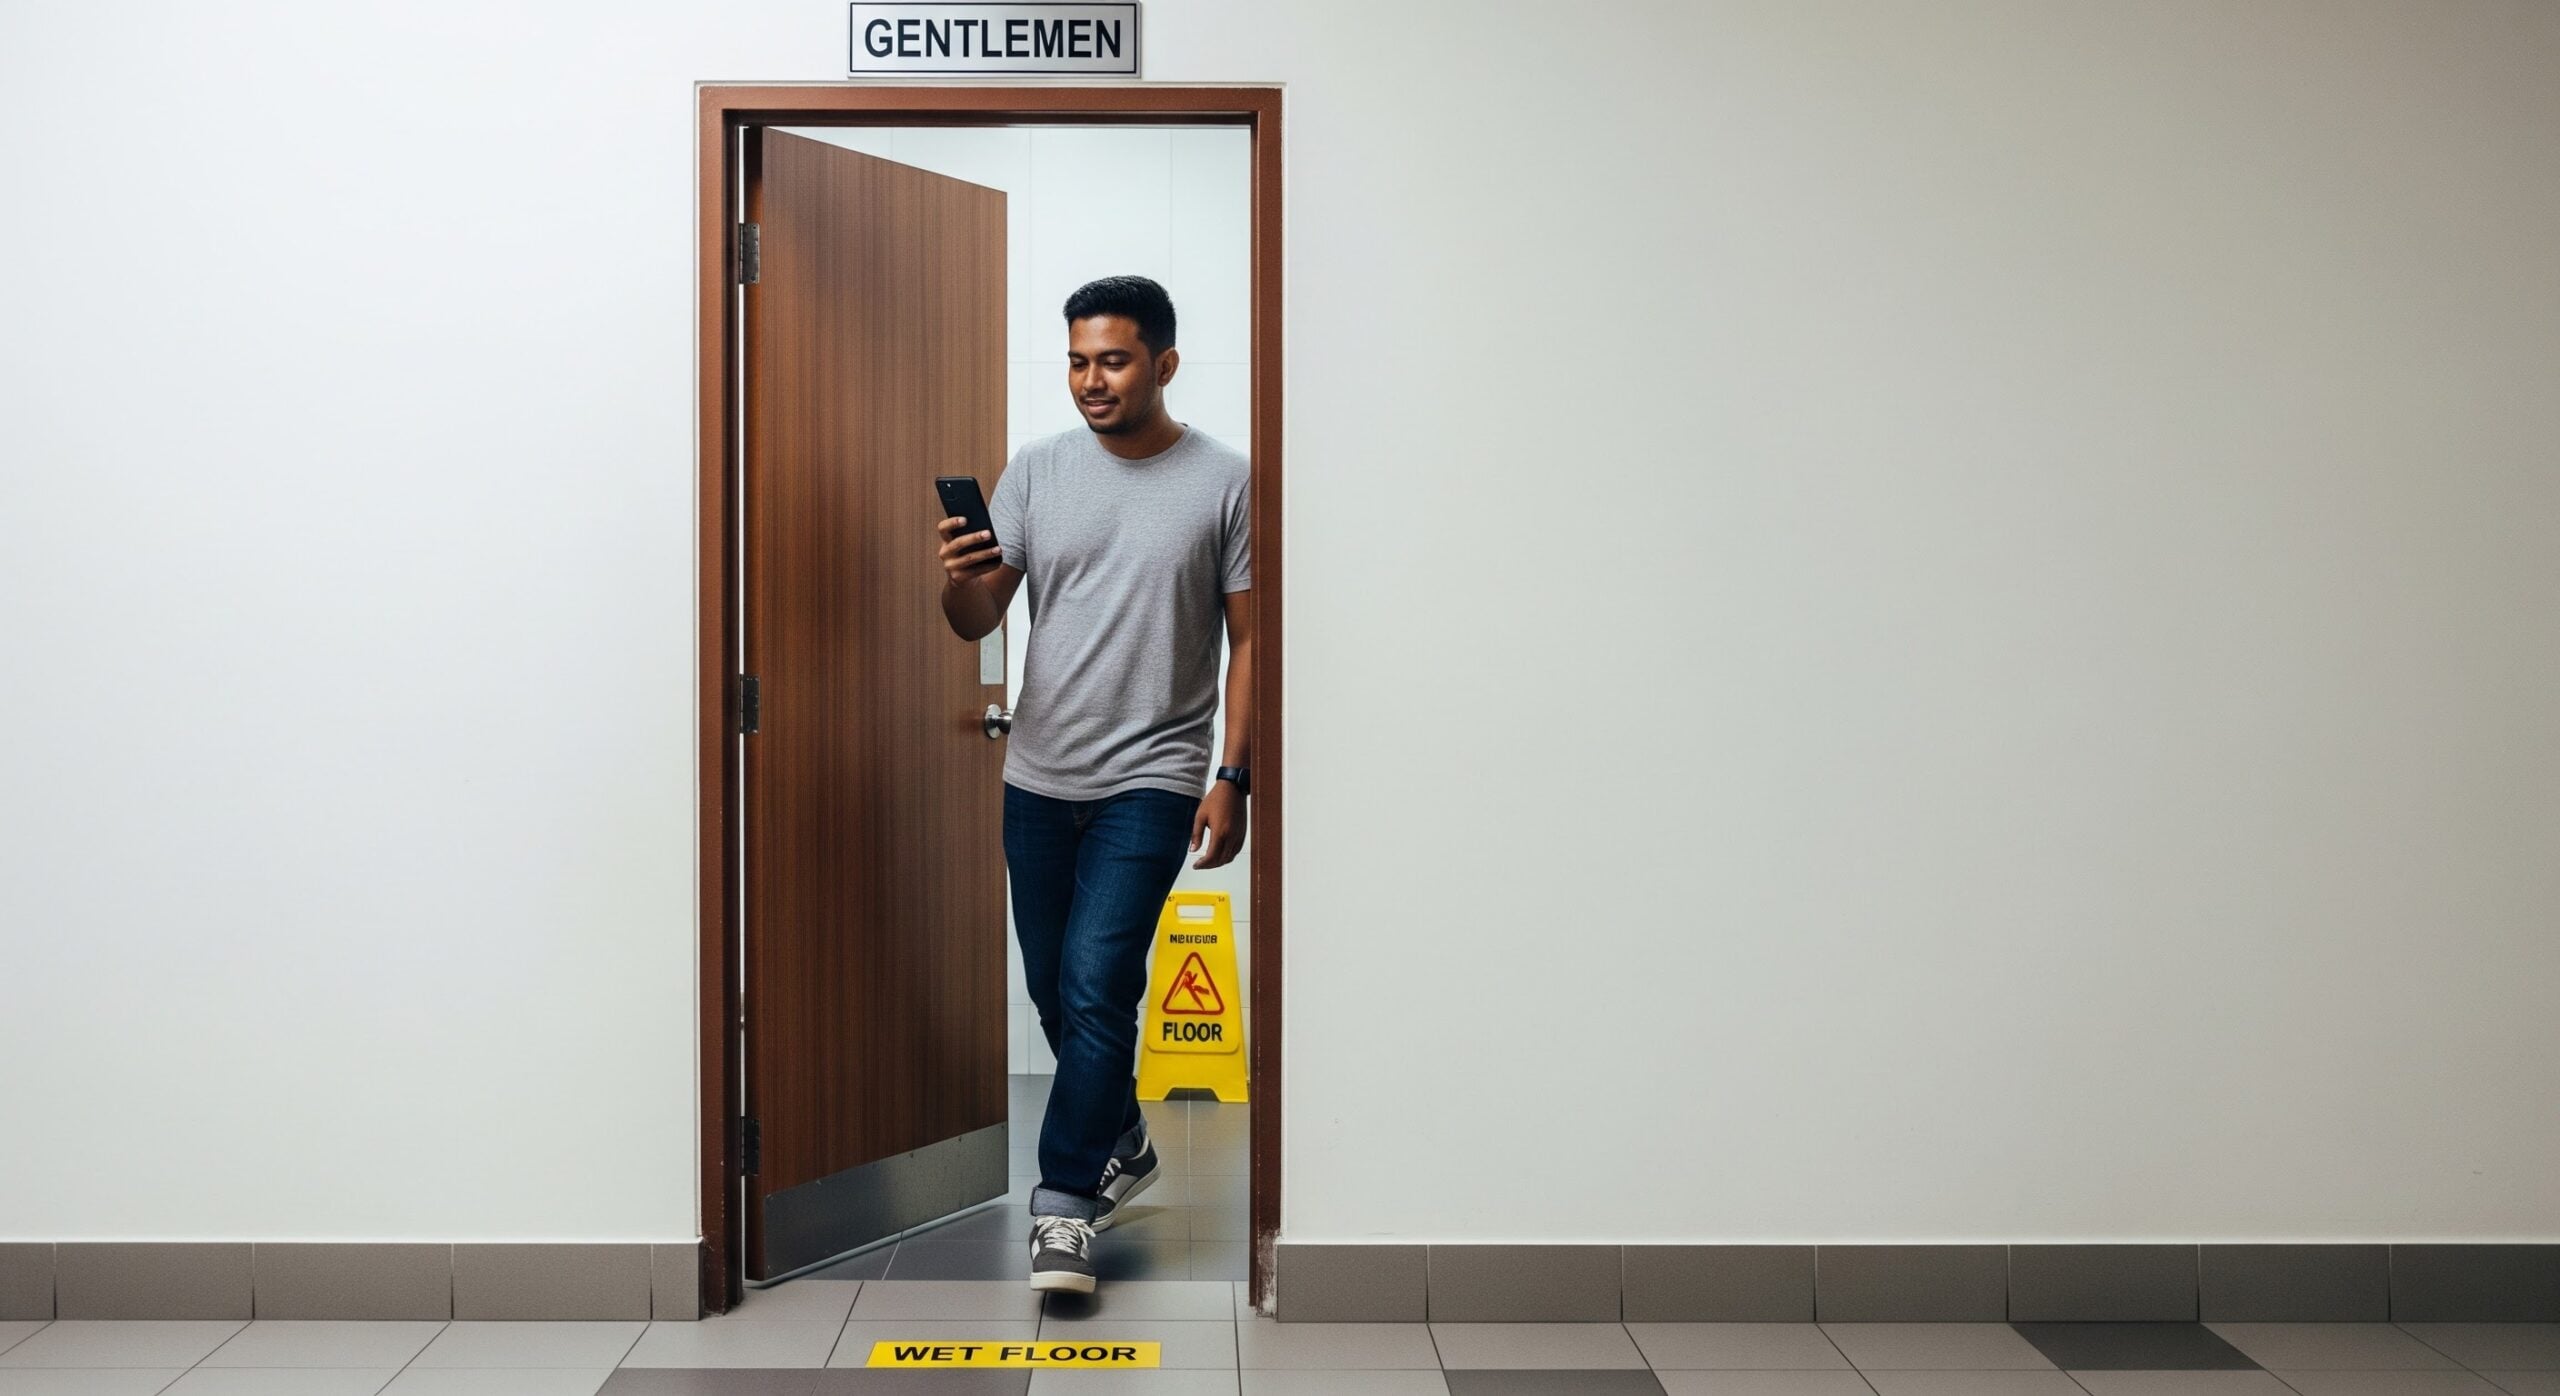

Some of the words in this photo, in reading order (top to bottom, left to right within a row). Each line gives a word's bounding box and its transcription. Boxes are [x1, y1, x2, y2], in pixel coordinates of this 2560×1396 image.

[865, 19, 1121, 58] GENTLEMEN
[1163, 1022, 1223, 1042] FLOOR
[894, 1346, 983, 1361] WET
[1000, 1346, 1137, 1361] FLOOR
